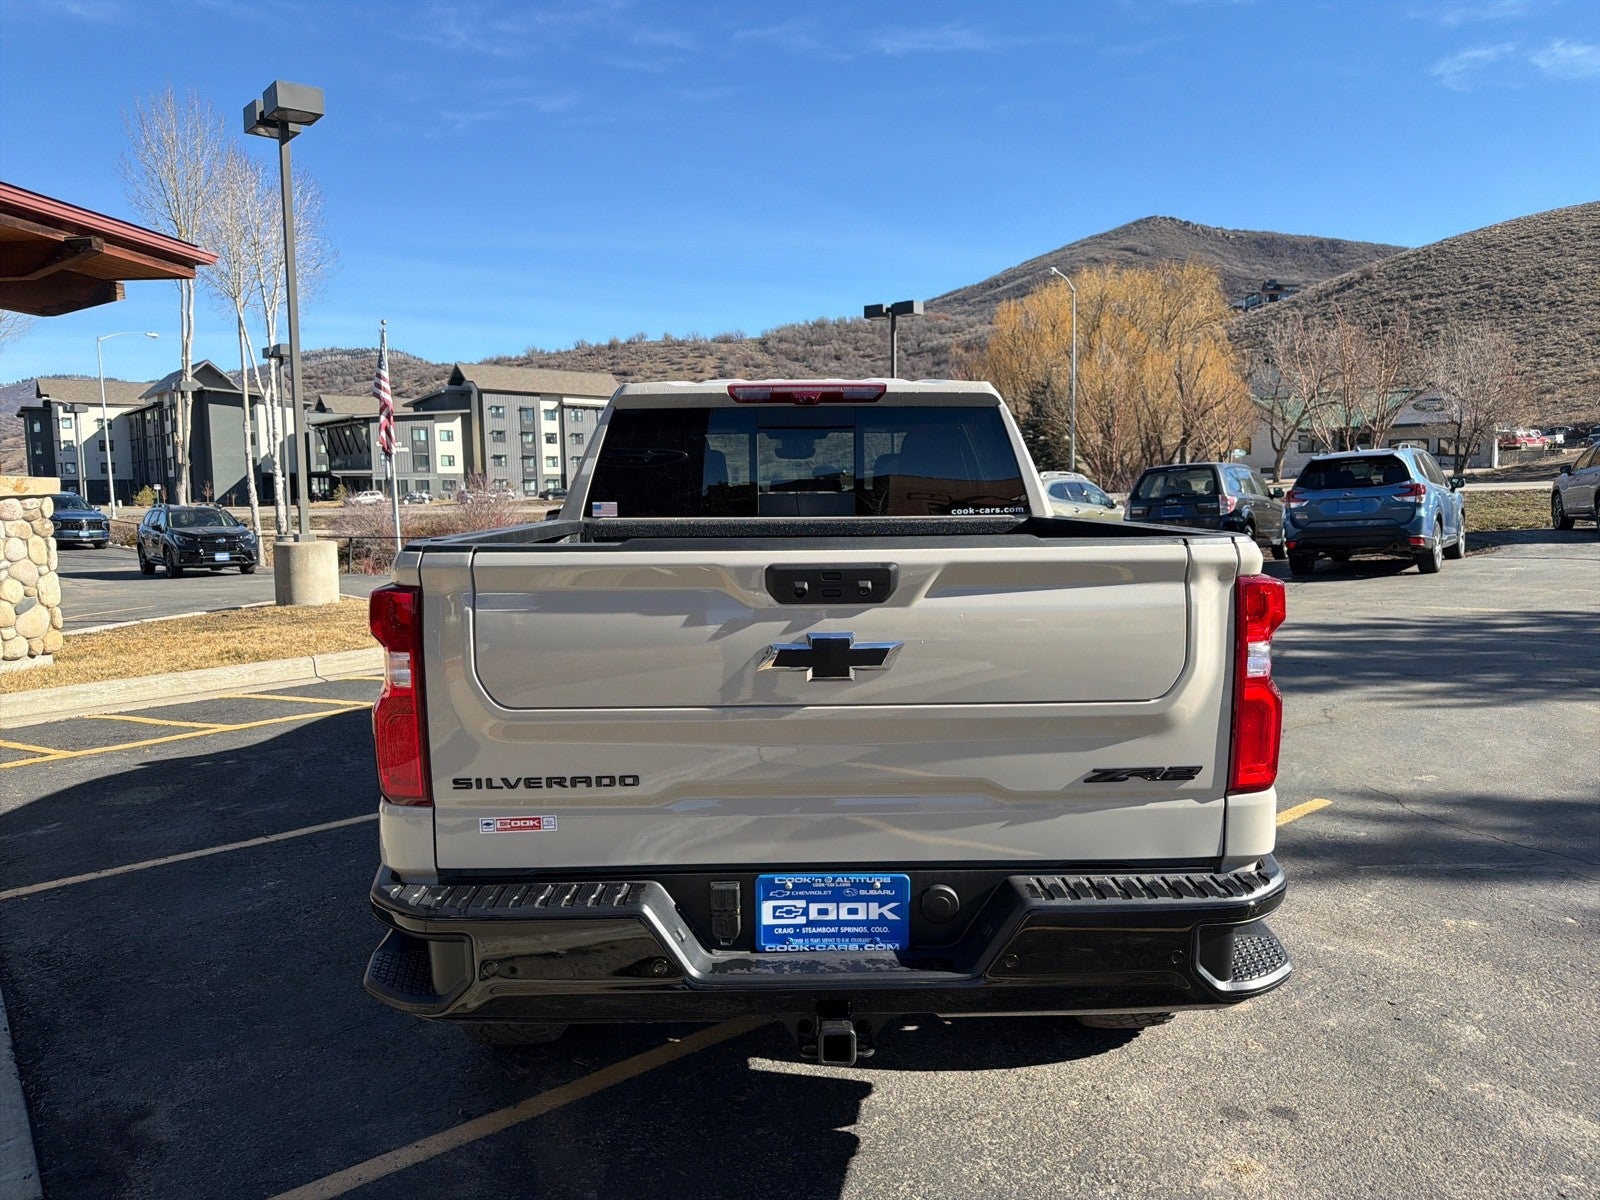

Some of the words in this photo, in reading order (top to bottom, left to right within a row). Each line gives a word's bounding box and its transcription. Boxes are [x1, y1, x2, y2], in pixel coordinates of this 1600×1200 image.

[951, 506, 1025, 515] cook-cars.com
[1083, 766, 1203, 783] ZR2
[452, 774, 640, 790] SILVERADO
[496, 819, 540, 828] COOK
[762, 899, 902, 926] COOK
[773, 927, 795, 935] CRAIG
[801, 926, 839, 934] STEAMBOAT
[840, 926, 869, 934] SPRINGS,
[765, 943, 900, 952] COOK-CARS.COM
